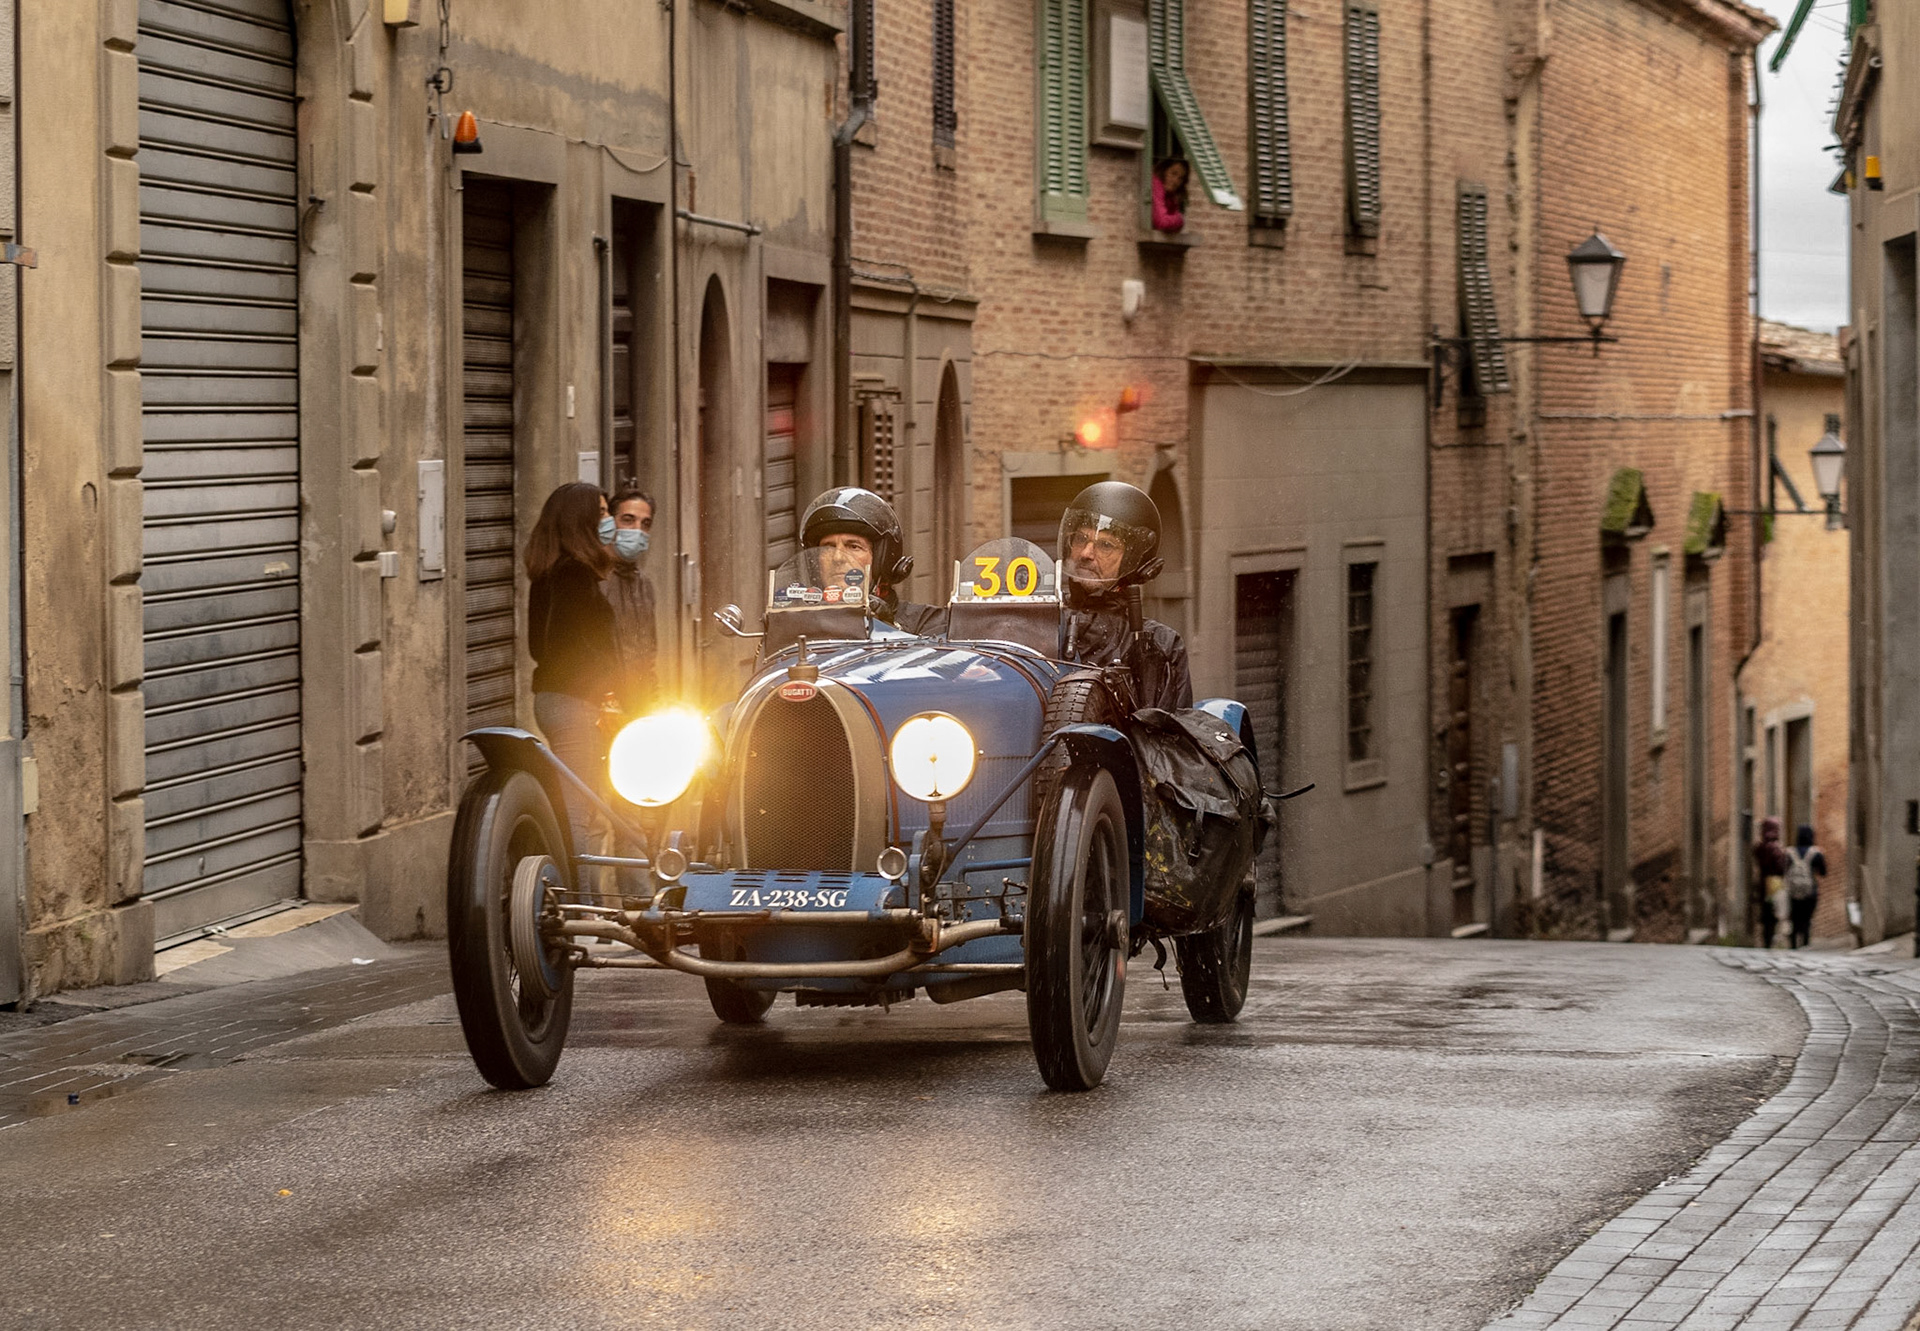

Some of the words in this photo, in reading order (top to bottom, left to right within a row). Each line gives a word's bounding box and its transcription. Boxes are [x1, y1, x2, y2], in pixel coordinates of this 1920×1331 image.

[973, 555, 1038, 598] 30
[782, 688, 813, 696] BUGATTI
[729, 889, 849, 908] ZA-238-SG
